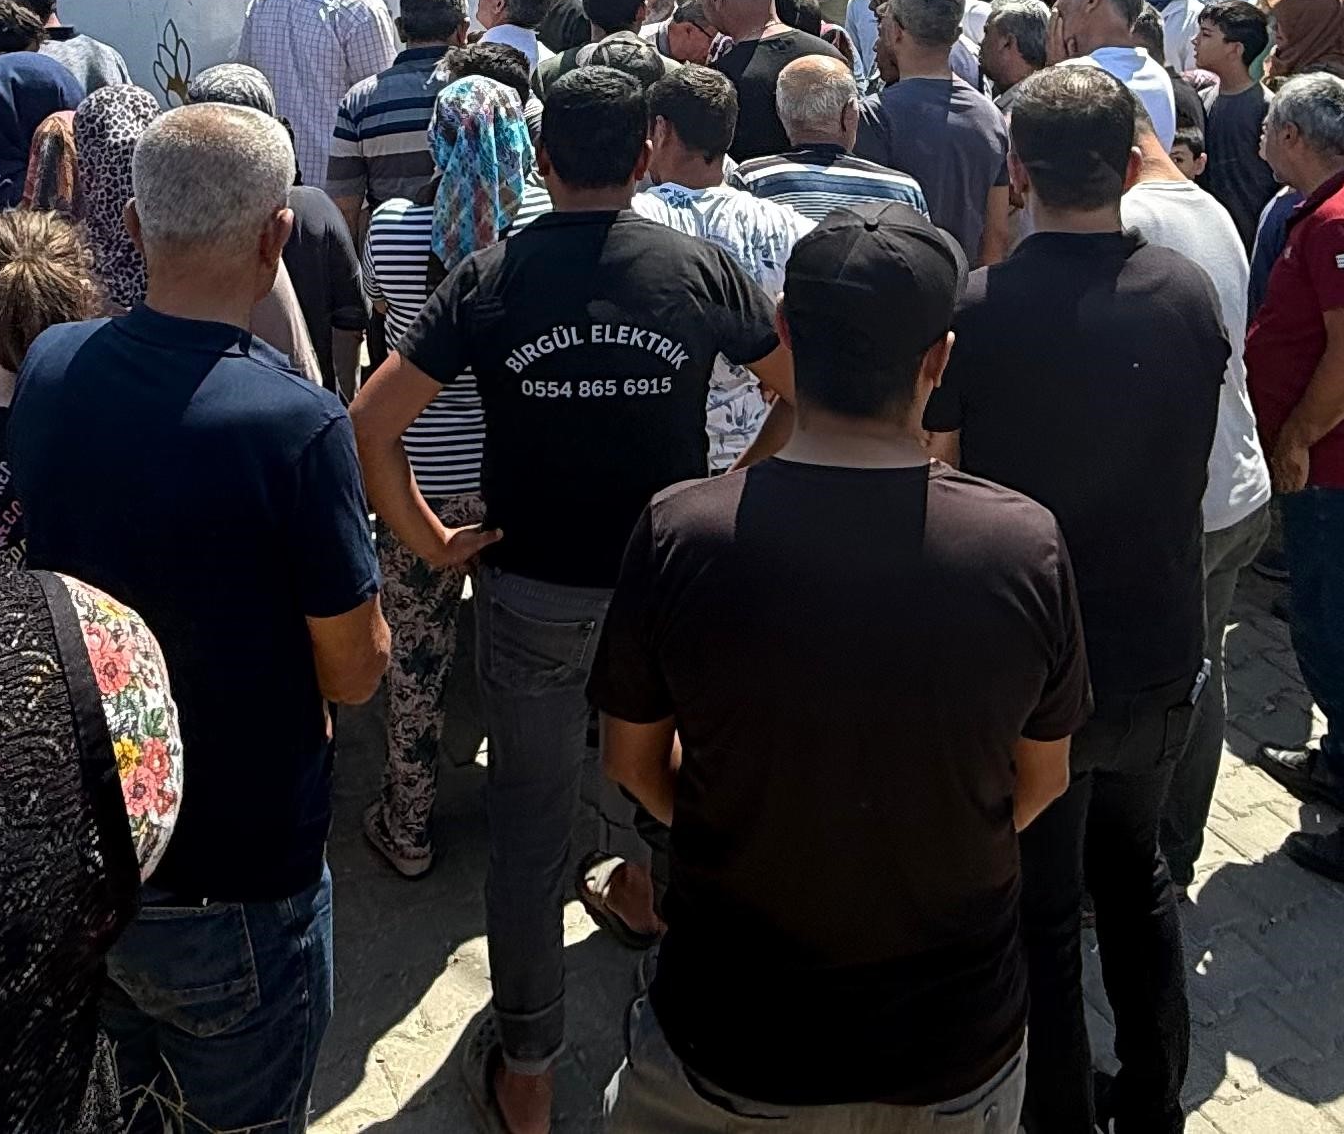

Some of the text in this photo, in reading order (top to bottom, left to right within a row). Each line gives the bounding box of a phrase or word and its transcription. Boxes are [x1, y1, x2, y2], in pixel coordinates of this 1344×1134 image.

[505, 324, 690, 373] BİRGÜL ELEKTRİK
[521, 377, 672, 398] 0554 865 6915
